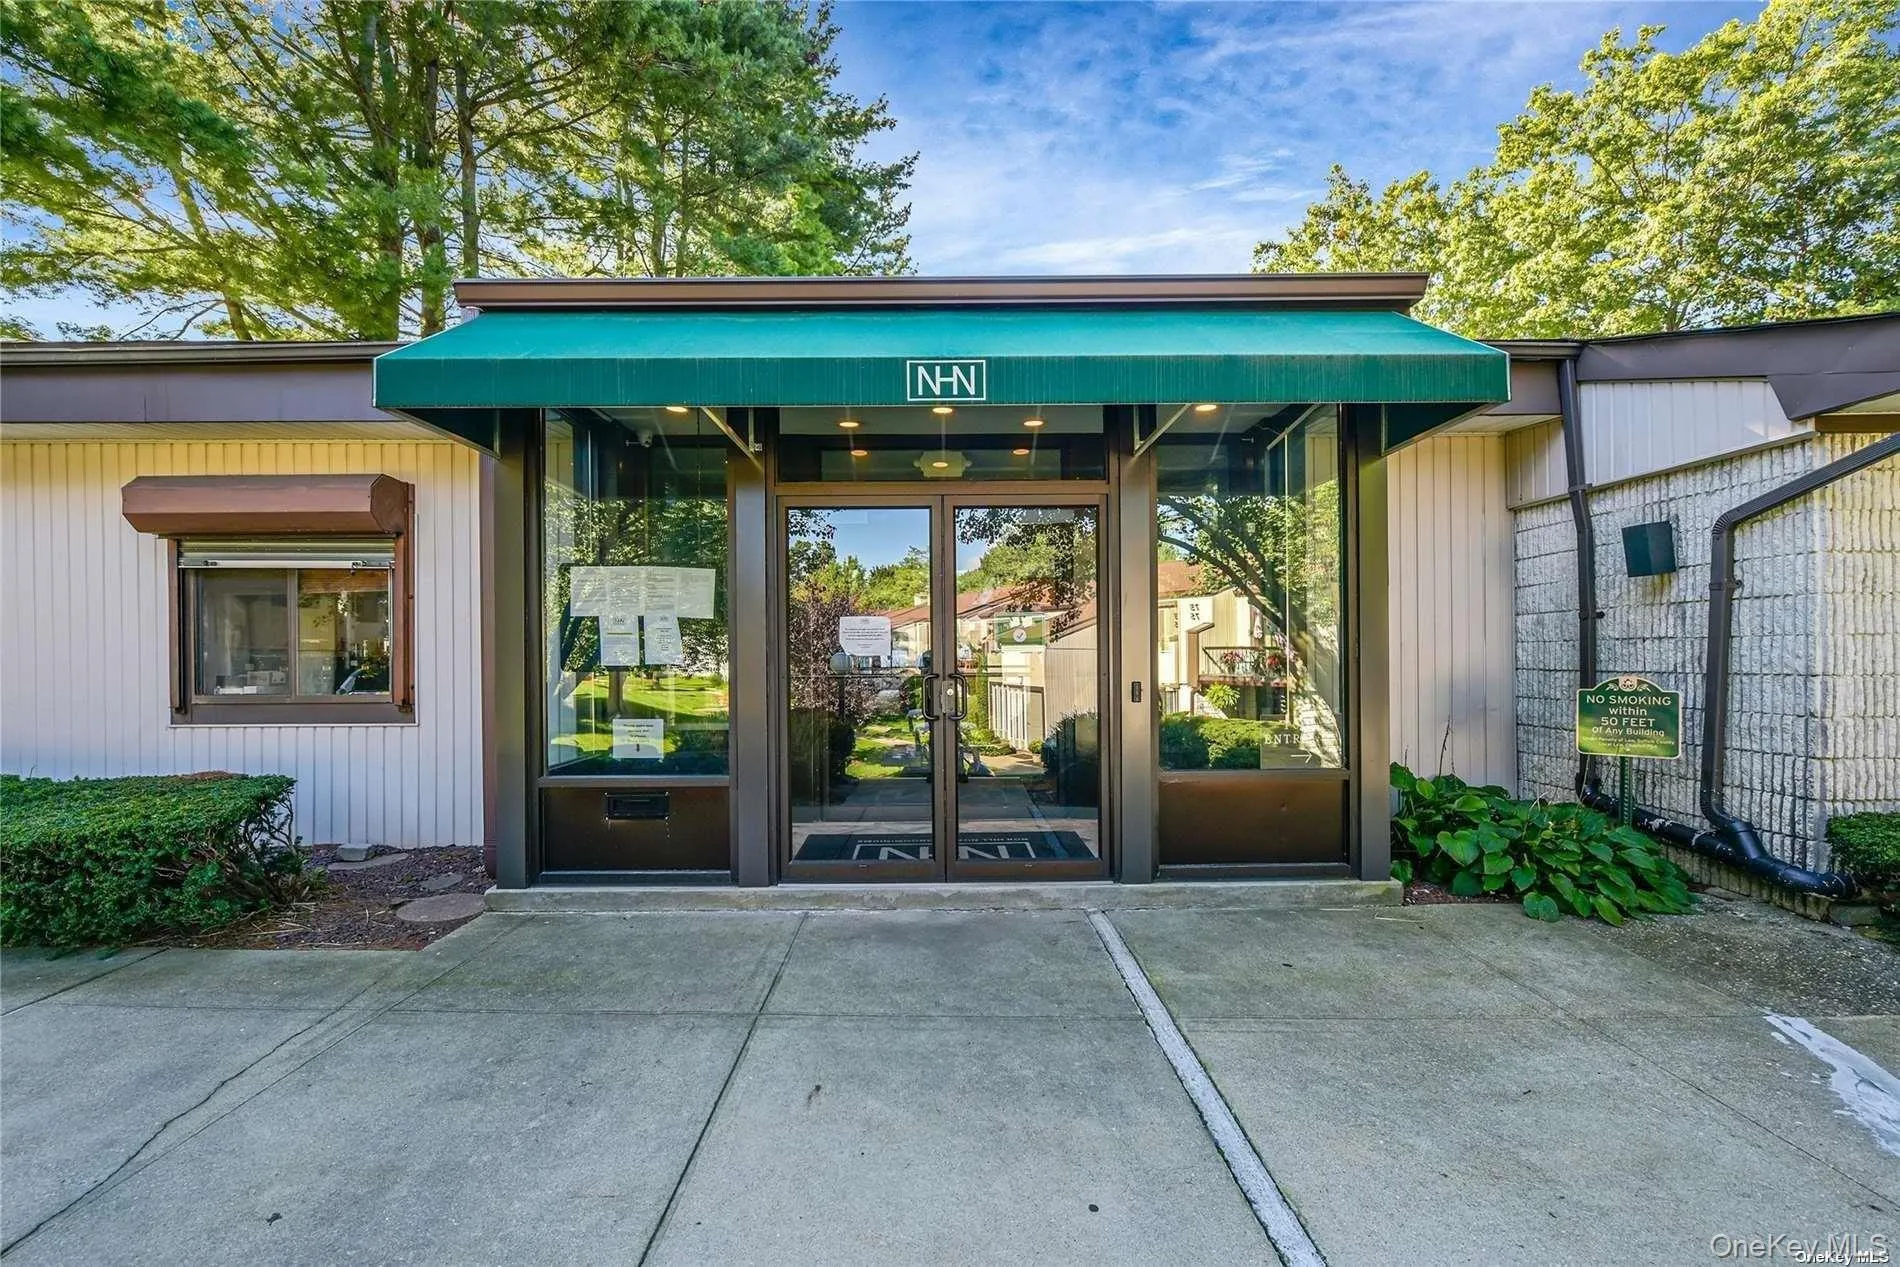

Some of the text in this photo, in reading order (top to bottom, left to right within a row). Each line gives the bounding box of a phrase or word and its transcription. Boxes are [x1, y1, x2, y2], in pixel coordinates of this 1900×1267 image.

[917, 365, 975, 396] NHN
[1586, 694, 1671, 706] NO SMOKING
[1609, 706, 1647, 716] within
[1601, 717, 1656, 727] 50 FEET
[1605, 727, 1623, 736] Any
[1626, 727, 1665, 737] Building
